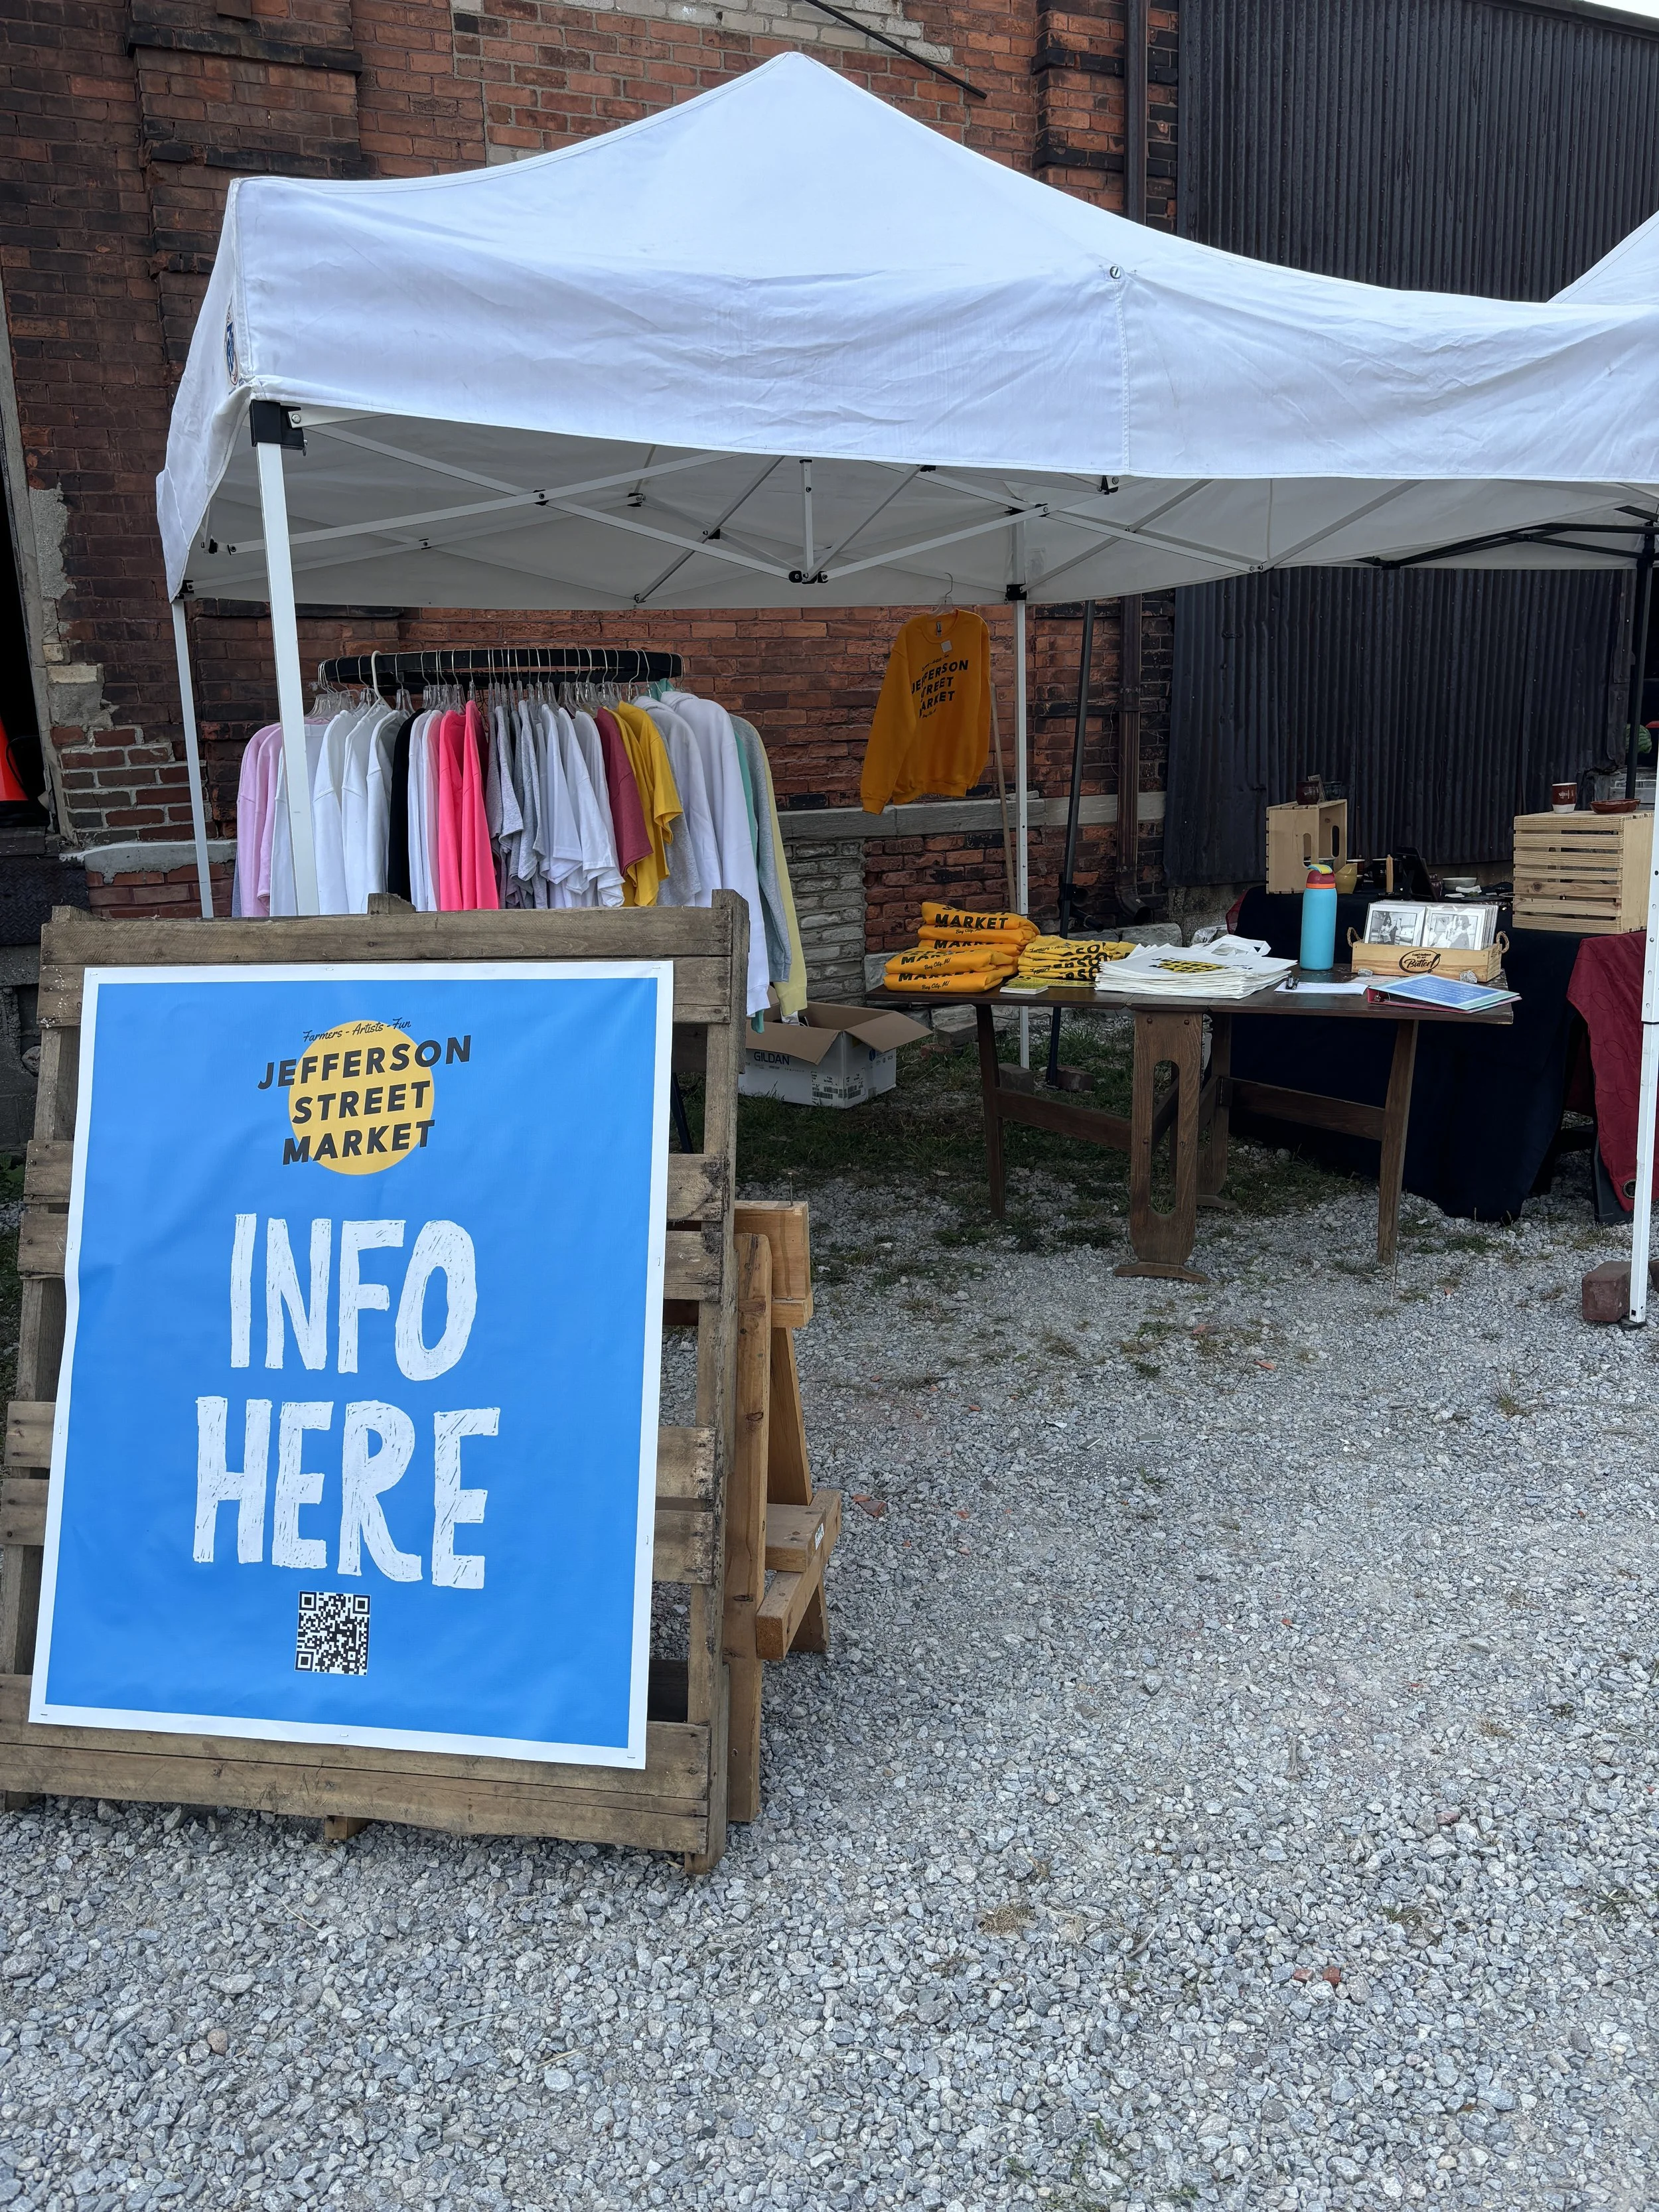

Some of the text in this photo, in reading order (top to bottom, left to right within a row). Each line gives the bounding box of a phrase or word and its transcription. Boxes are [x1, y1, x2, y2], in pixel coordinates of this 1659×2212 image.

[919, 691, 955, 718] ARKET
[935, 914, 1009, 929] MARKET
[303, 1029, 342, 1043] Farmers
[352, 1021, 384, 1035] Artists
[392, 1017, 411, 1029] Fun
[257, 1035, 471, 1090] JEFFERSON
[754, 1051, 790, 1065] GILDAN
[292, 1080, 430, 1124] STREET
[283, 1120, 435, 1165] MARKET
[230, 1213, 477, 1381] INFO
[192, 1396, 500, 1589] HERE
